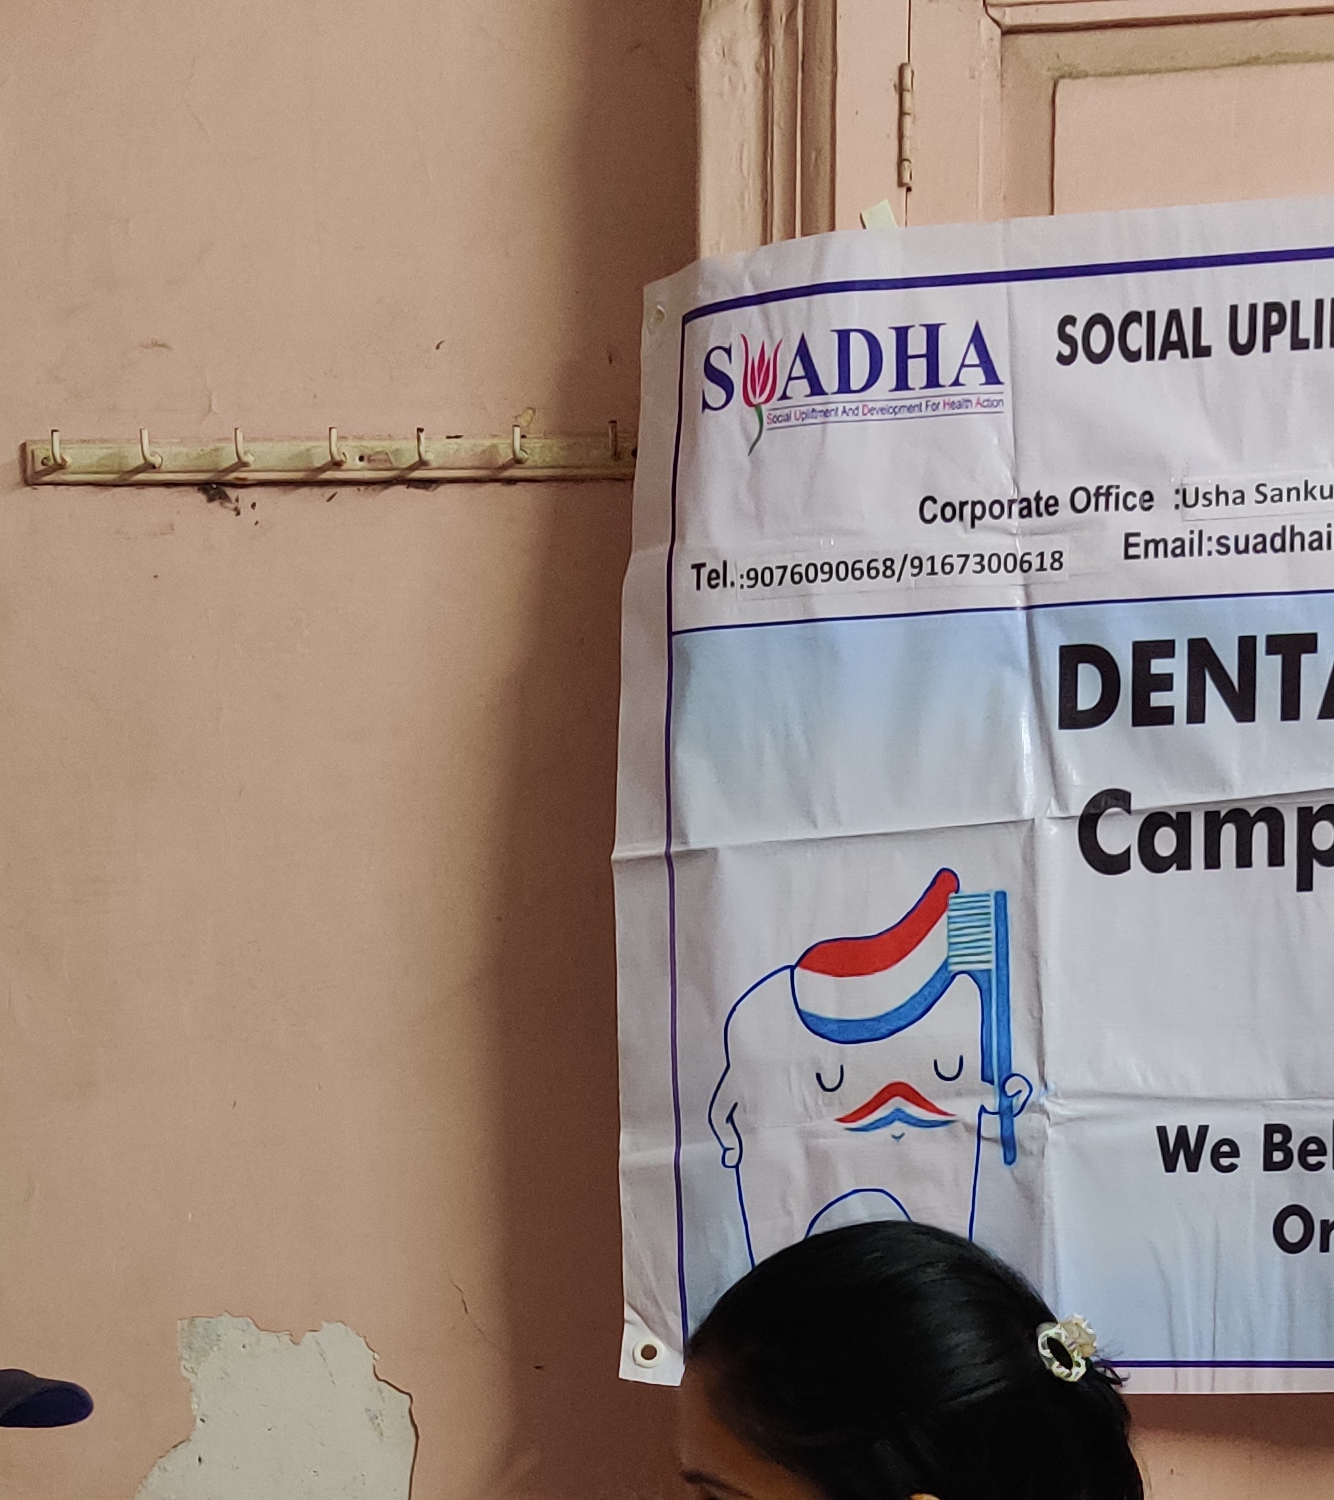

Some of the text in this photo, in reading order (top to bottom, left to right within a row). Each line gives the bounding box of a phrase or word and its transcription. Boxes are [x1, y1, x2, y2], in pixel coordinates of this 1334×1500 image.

[1055, 307, 1212, 367] SOCIAL
[840, 405, 860, 417] And
[925, 400, 941, 412] For
[918, 487, 1060, 528] Corporate
[1068, 484, 1155, 516] Office
[1156, 1123, 1240, 1174] We
